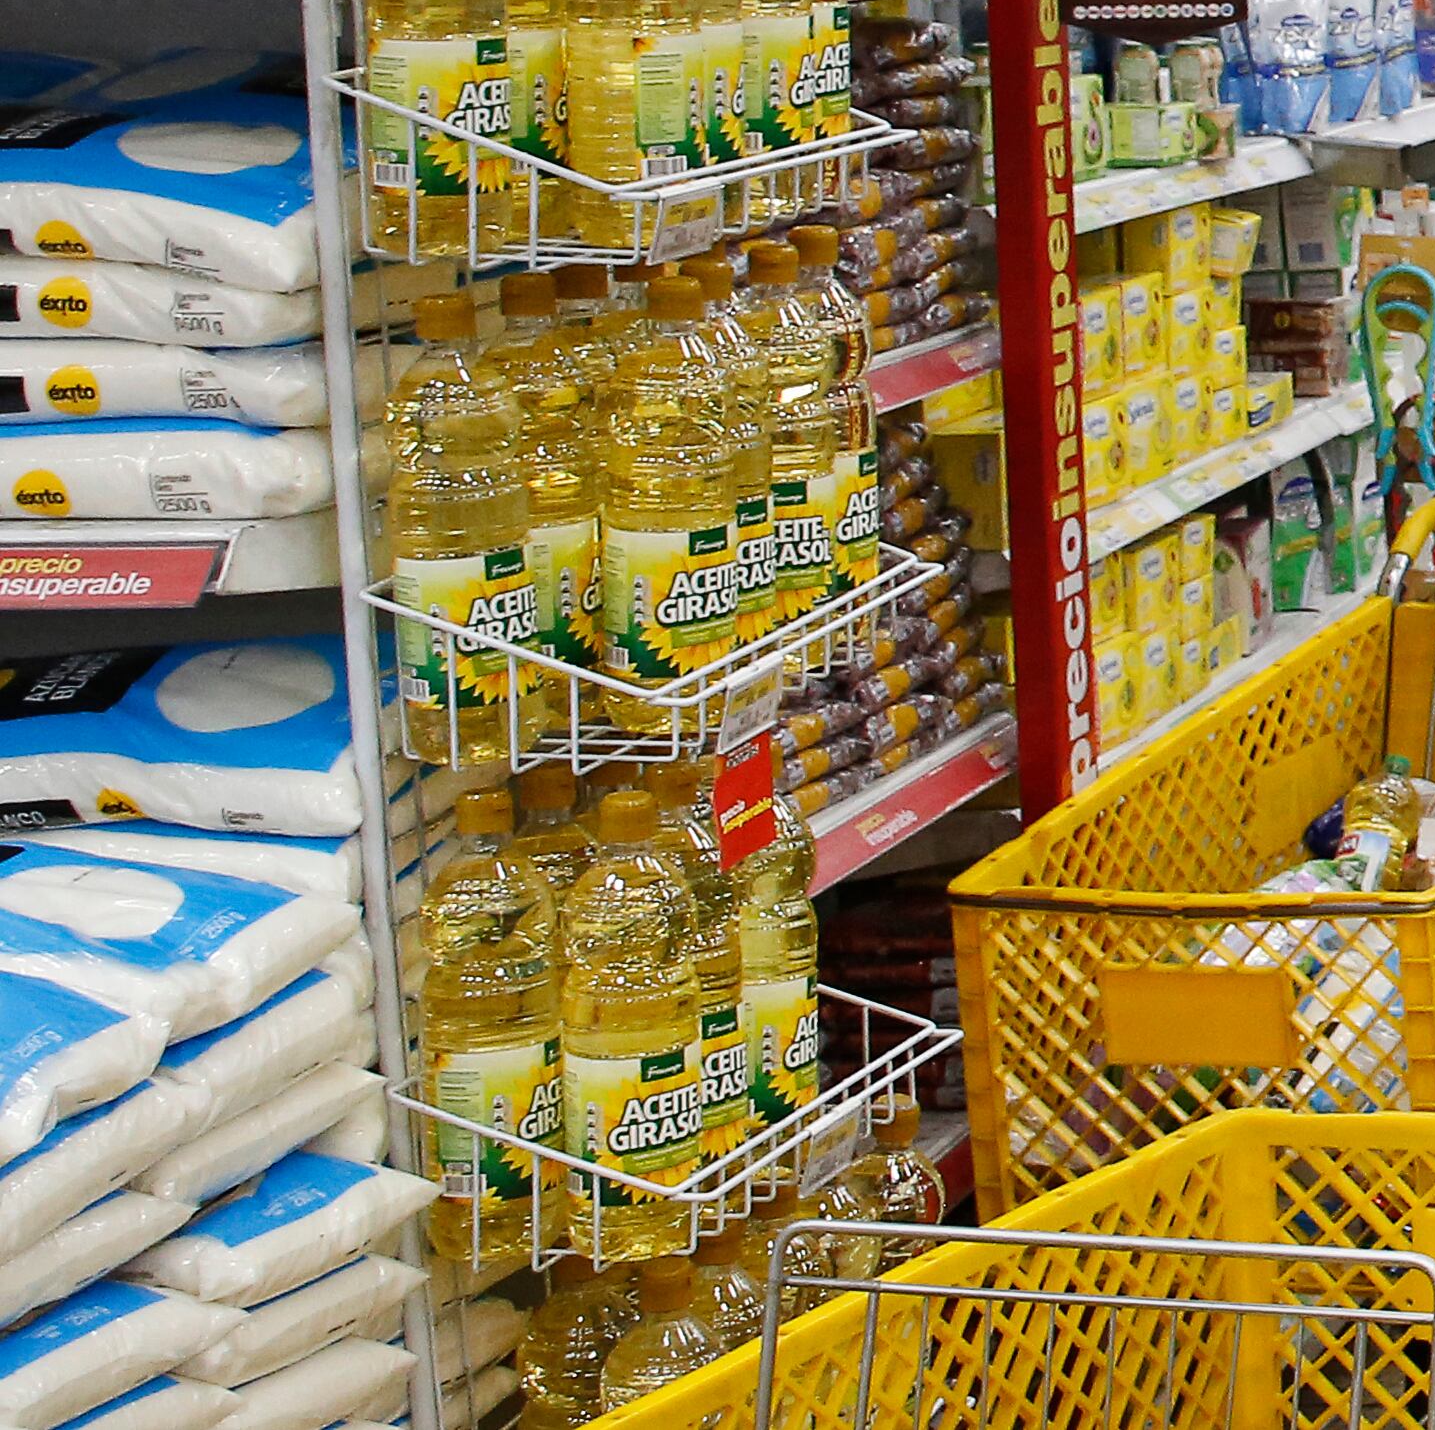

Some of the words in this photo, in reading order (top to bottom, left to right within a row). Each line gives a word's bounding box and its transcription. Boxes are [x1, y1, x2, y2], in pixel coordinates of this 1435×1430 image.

[39, 294, 88, 316] éxito
[49, 383, 97, 403] éxito
[188, 393, 227, 410] 2500
[17, 489, 66, 508] éxito
[158, 498, 198, 513] 2500
[0, 553, 84, 574] precio
[620, 1082, 700, 1126] ACEITE
